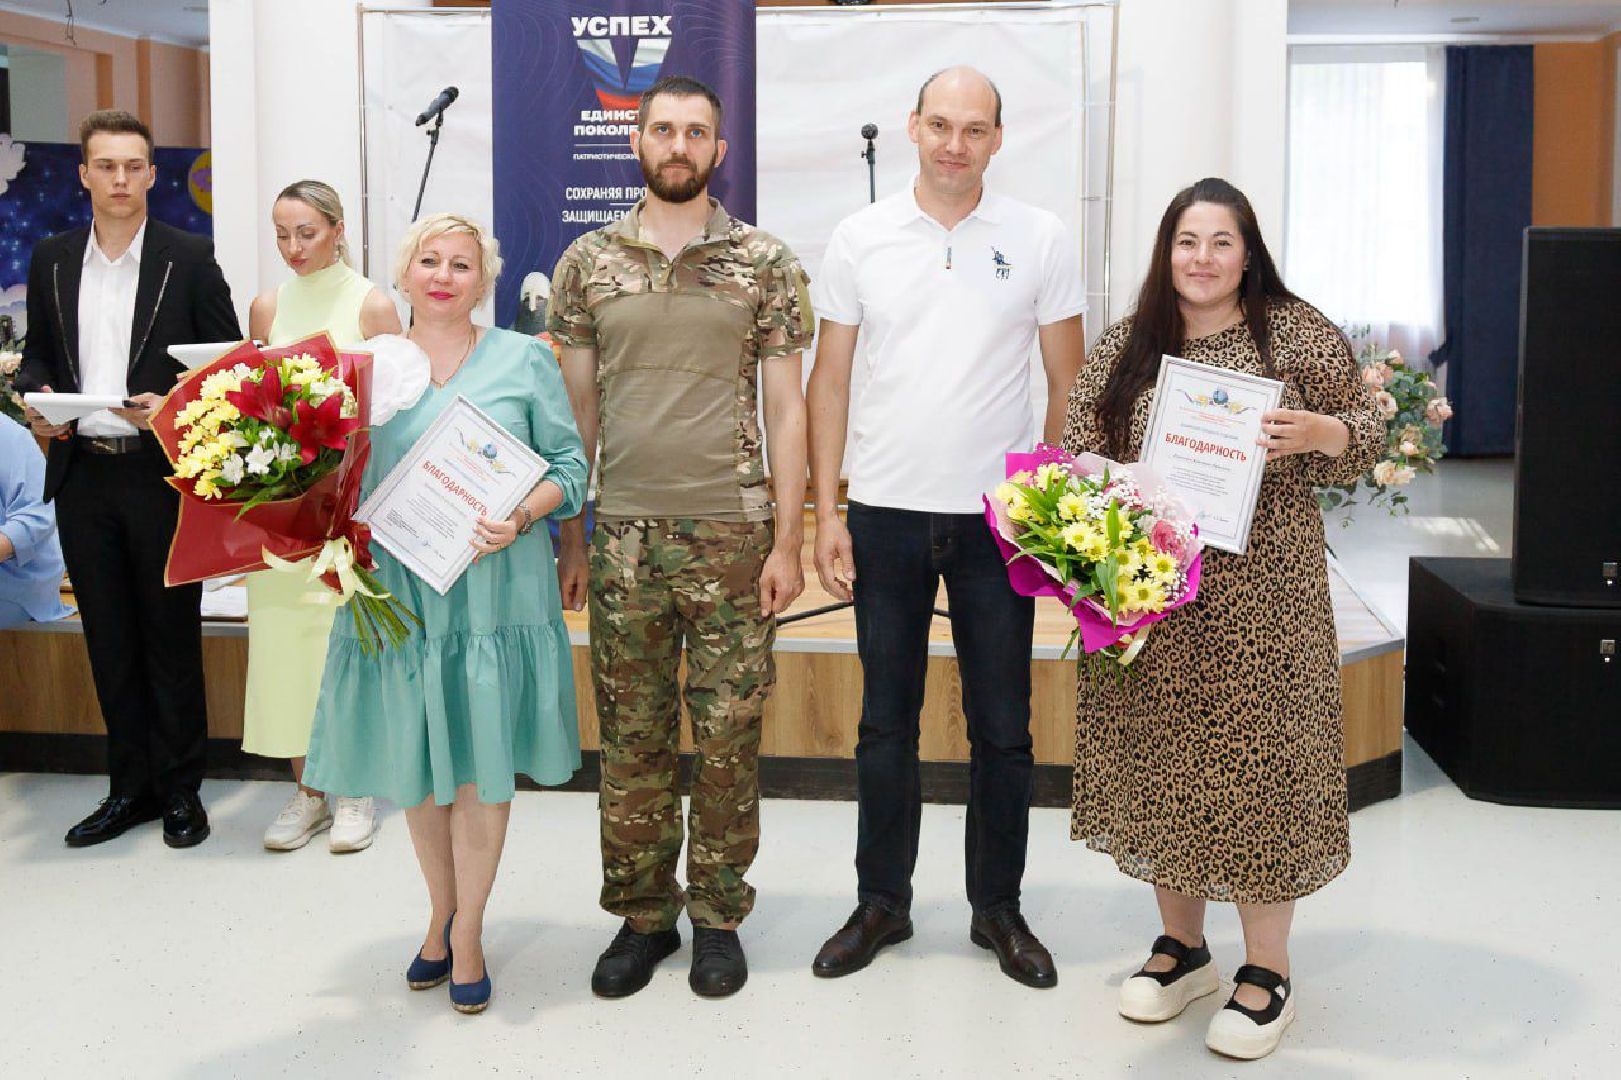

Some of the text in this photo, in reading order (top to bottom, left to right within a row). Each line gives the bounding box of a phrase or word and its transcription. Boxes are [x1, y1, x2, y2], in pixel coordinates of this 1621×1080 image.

[571, 15, 673, 37] УСПЕХ
[566, 187, 622, 200] СОХРАНЯЯ
[1165, 433, 1247, 461] БЛАГОДАРНОСТЬ
[422, 459, 488, 516] БЛАГОДАРНОСТЬ
